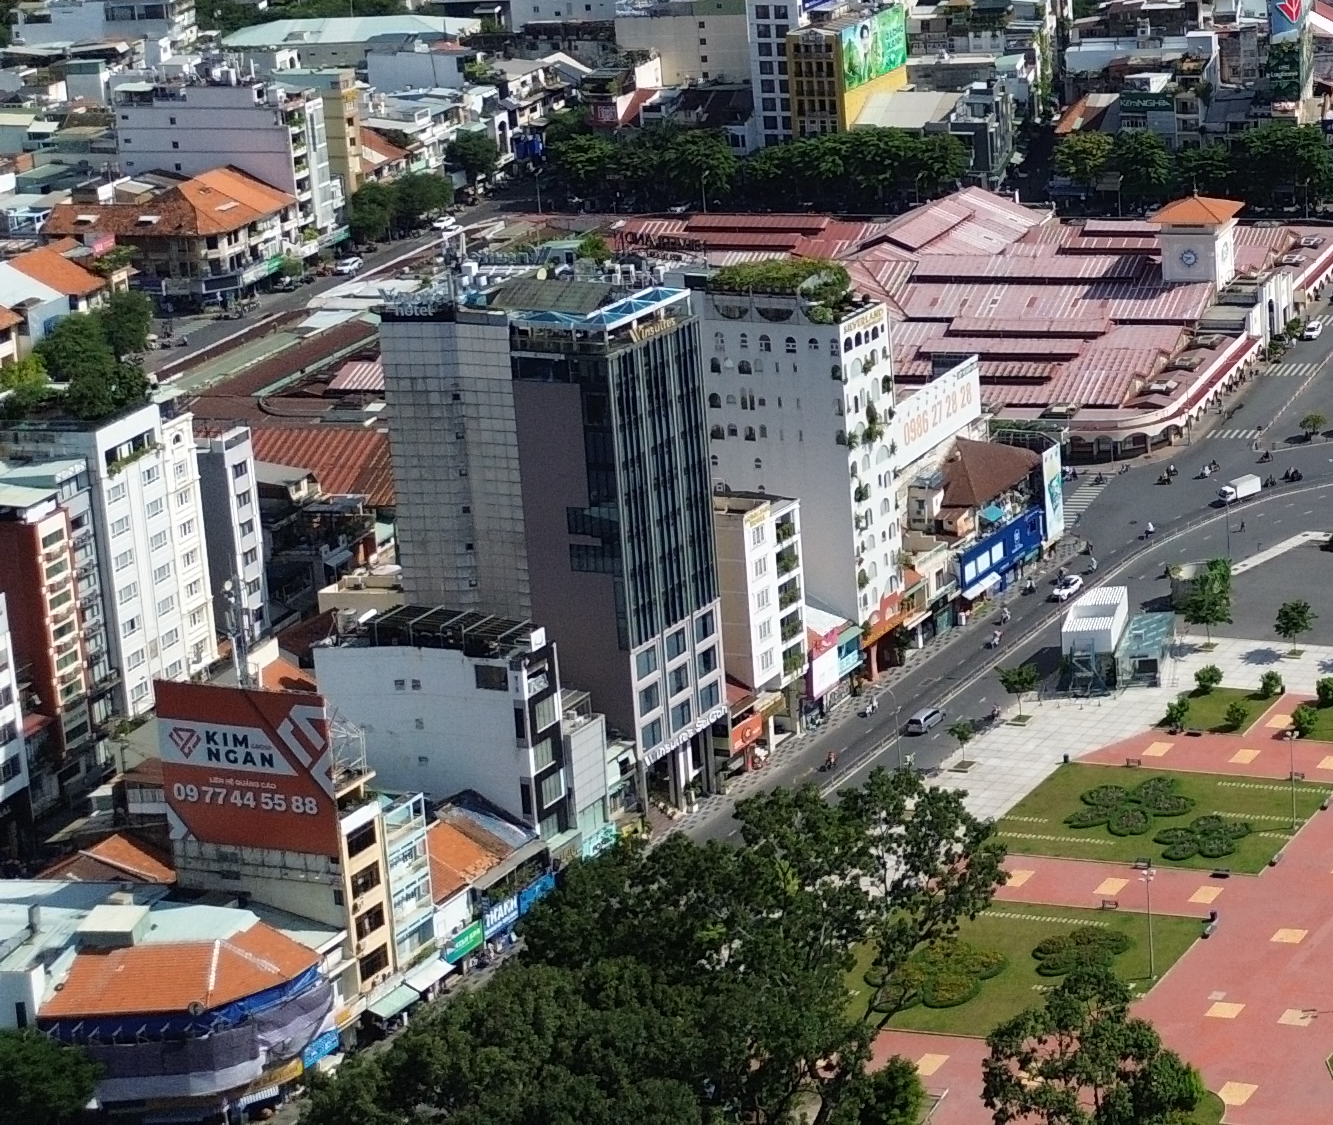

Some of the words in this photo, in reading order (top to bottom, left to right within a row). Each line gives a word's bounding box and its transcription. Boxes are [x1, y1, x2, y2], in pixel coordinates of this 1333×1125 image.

[904, 413, 928, 446] 0986
[932, 405, 943, 426] 27
[946, 397, 958, 419] 28
[960, 381, 972, 407] 28
[205, 730, 249, 749] KIM
[206, 746, 274, 768] NGAN
[173, 782, 198, 802] 09
[201, 786, 226, 805] 77
[230, 790, 256, 809] 44
[261, 793, 286, 812] 55
[291, 797, 318, 815] 88
